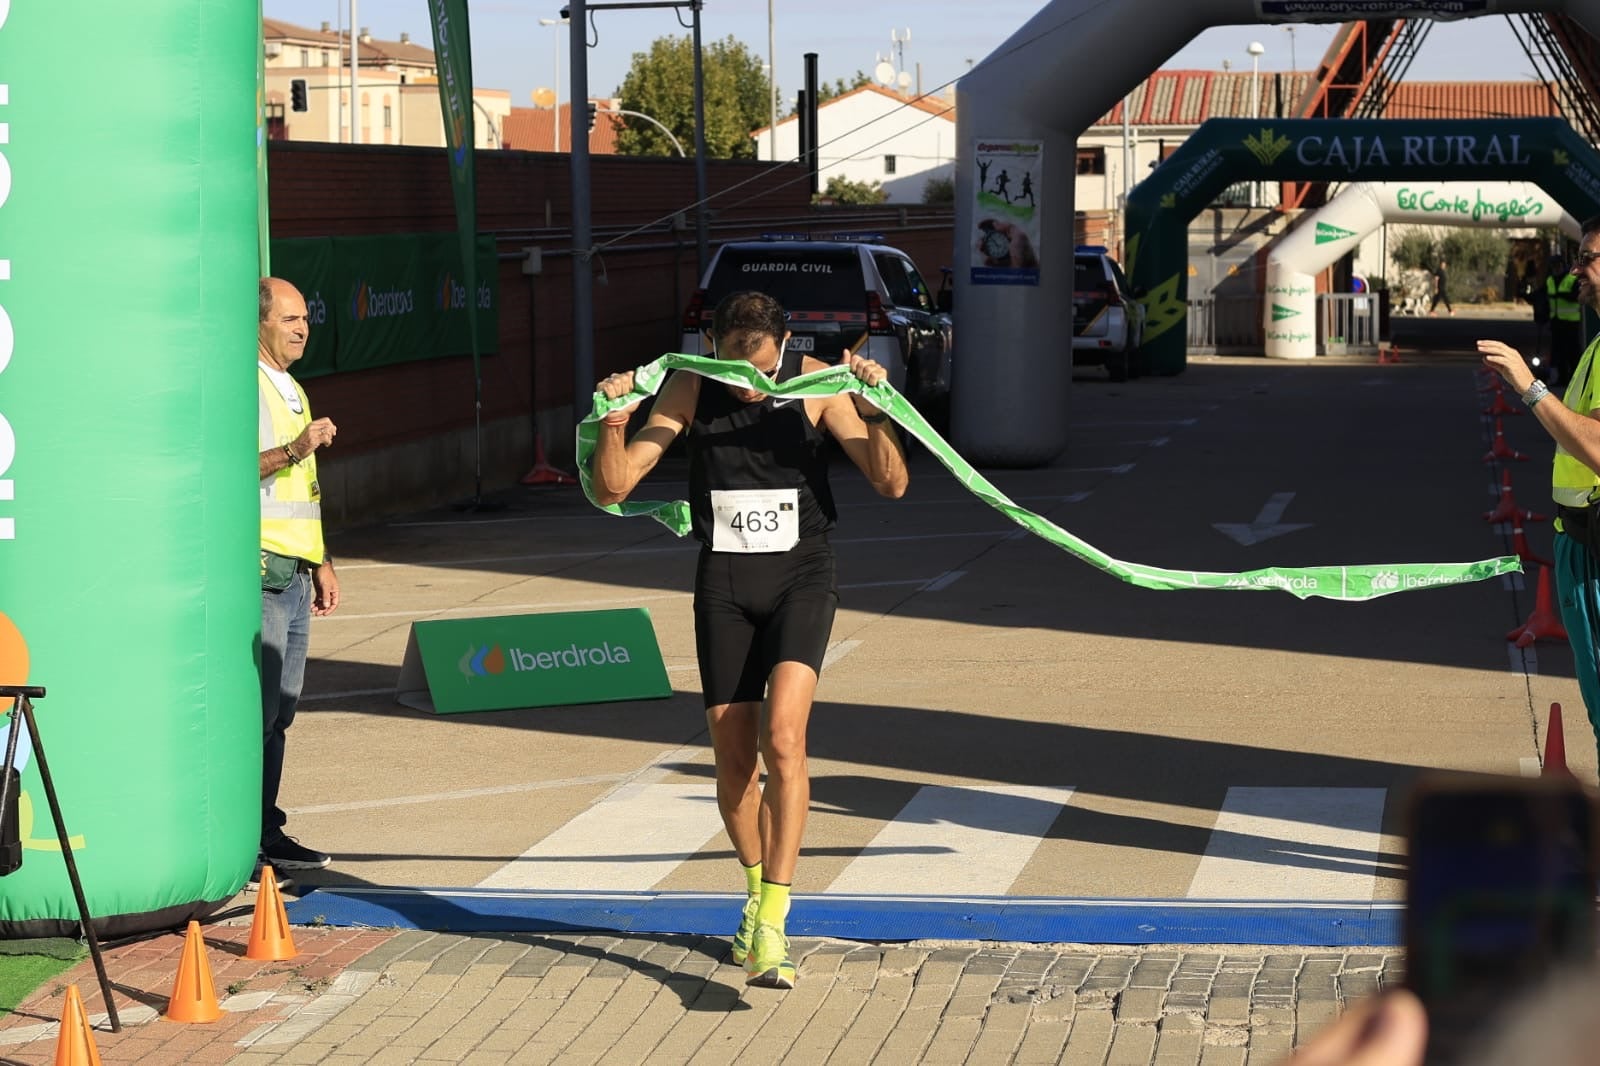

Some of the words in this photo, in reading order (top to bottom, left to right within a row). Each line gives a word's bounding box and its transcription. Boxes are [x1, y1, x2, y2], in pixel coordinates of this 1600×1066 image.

[1296, 136, 1390, 173] CAJA
[1401, 134, 1531, 166] RURAL
[1397, 188, 1417, 210] El
[1420, 191, 1469, 214] Corte
[1472, 187, 1543, 222] Inglés
[742, 263, 797, 272] GUARDIA
[801, 264, 832, 274] CIVIL
[367, 284, 414, 318] Iberdroa
[730, 510, 779, 533] 463
[510, 641, 631, 672] Iberdrola
